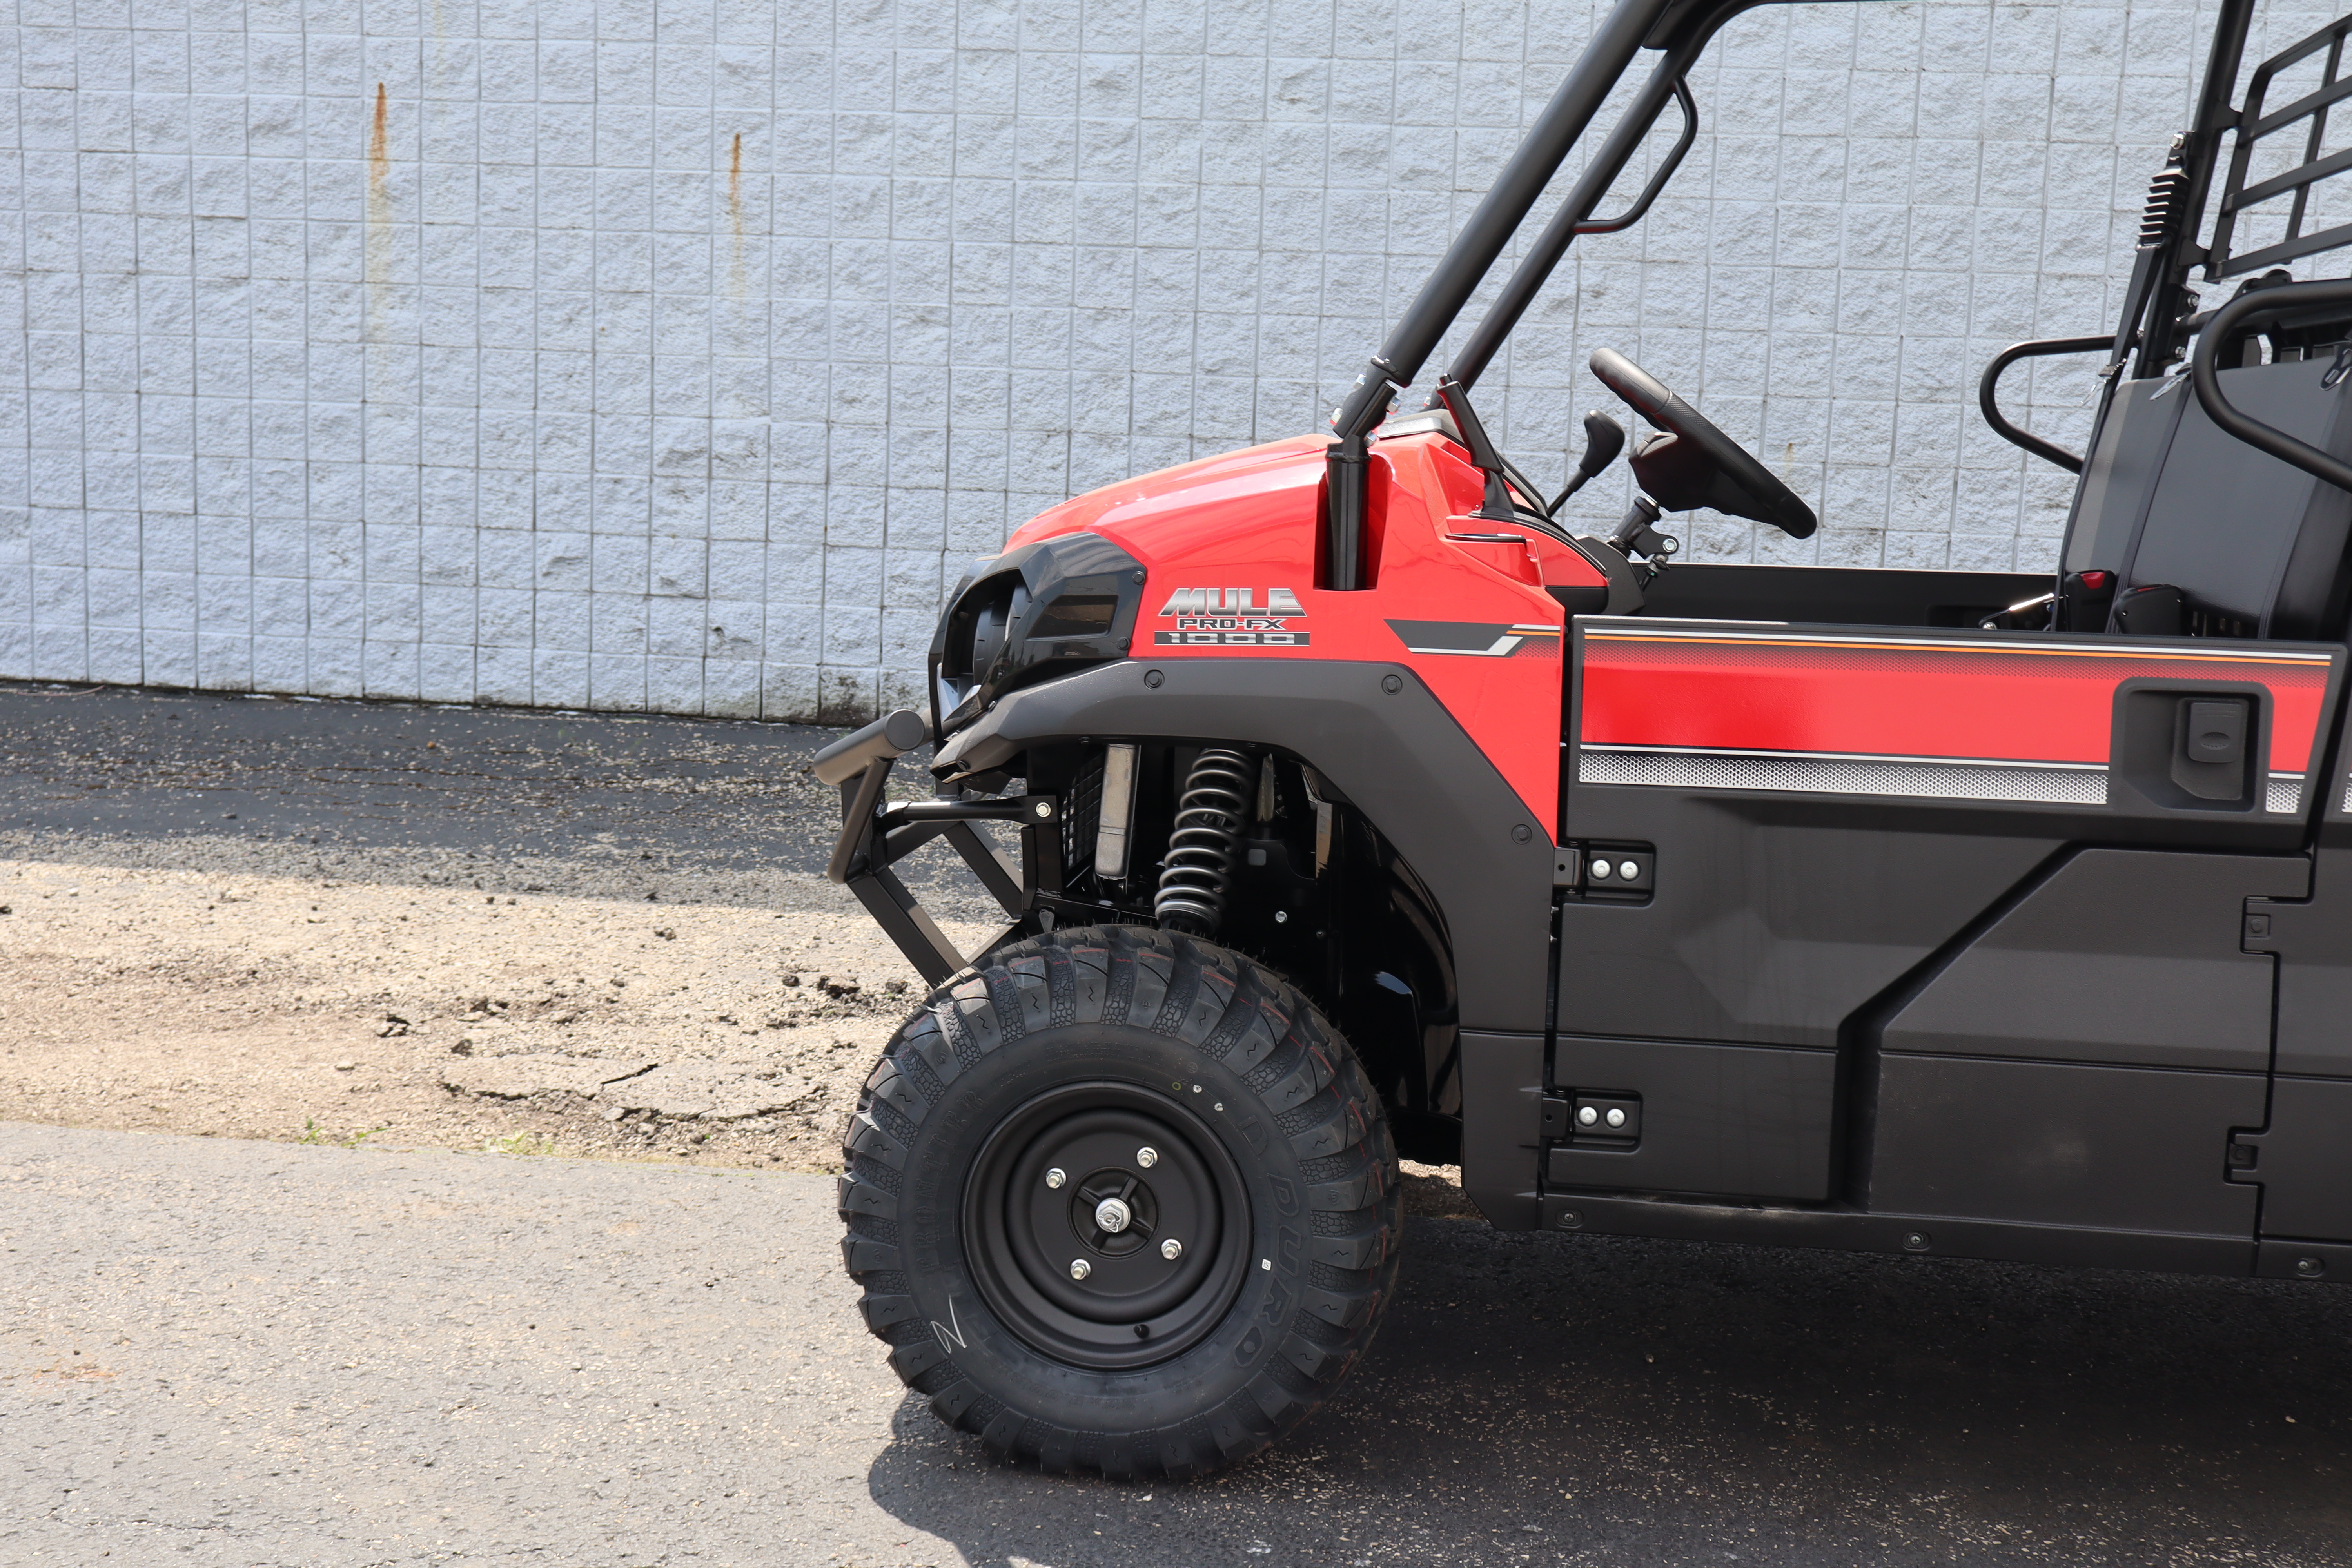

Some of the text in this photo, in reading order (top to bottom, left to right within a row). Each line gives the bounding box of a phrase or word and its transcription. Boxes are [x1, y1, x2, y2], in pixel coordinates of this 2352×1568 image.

[1158, 588, 1308, 617] MULE
[1168, 633, 1295, 644] 1000
[1177, 618, 1287, 631] PRO-FX
[914, 1091, 988, 1276] FRONTIER
[1235, 1173, 1301, 1368] DURO
